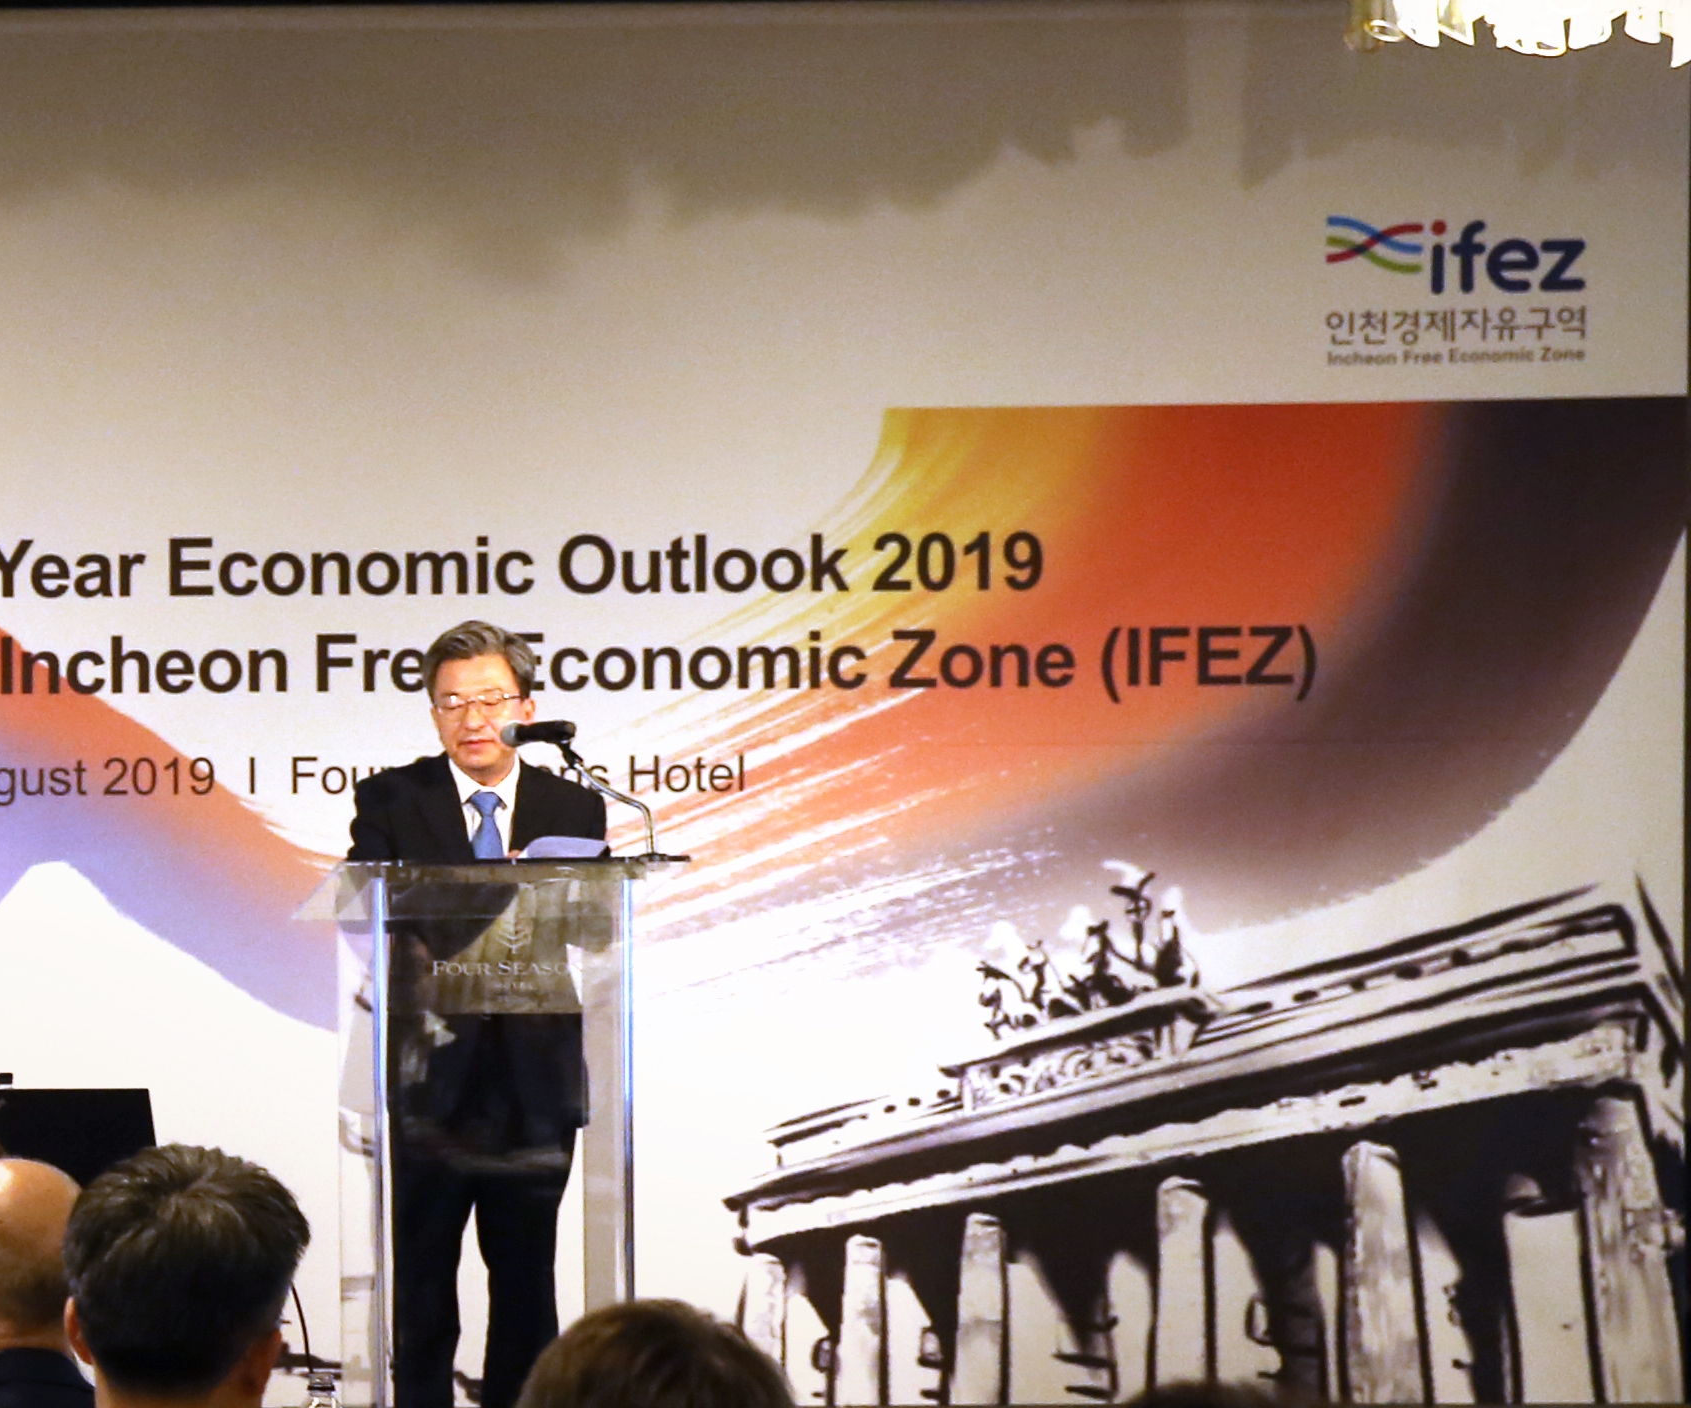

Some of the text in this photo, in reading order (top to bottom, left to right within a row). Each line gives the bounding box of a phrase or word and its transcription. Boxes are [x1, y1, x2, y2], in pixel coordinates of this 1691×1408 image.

[1430, 218, 1587, 295] ifez
[1325, 305, 1587, 346] 인천경제자유구역
[1327, 347, 1586, 365] Incheon Free Economic Zone
[167, 533, 536, 597] Economic
[558, 533, 849, 595] Outlook
[872, 531, 1043, 592] 2019
[1, 635, 287, 694] Incheon
[316, 633, 426, 692] Fre
[886, 629, 1075, 690] Zone
[1101, 624, 1316, 703] (IFEZ)
[104, 757, 220, 795] 2019
[625, 755, 749, 796] Hotel
